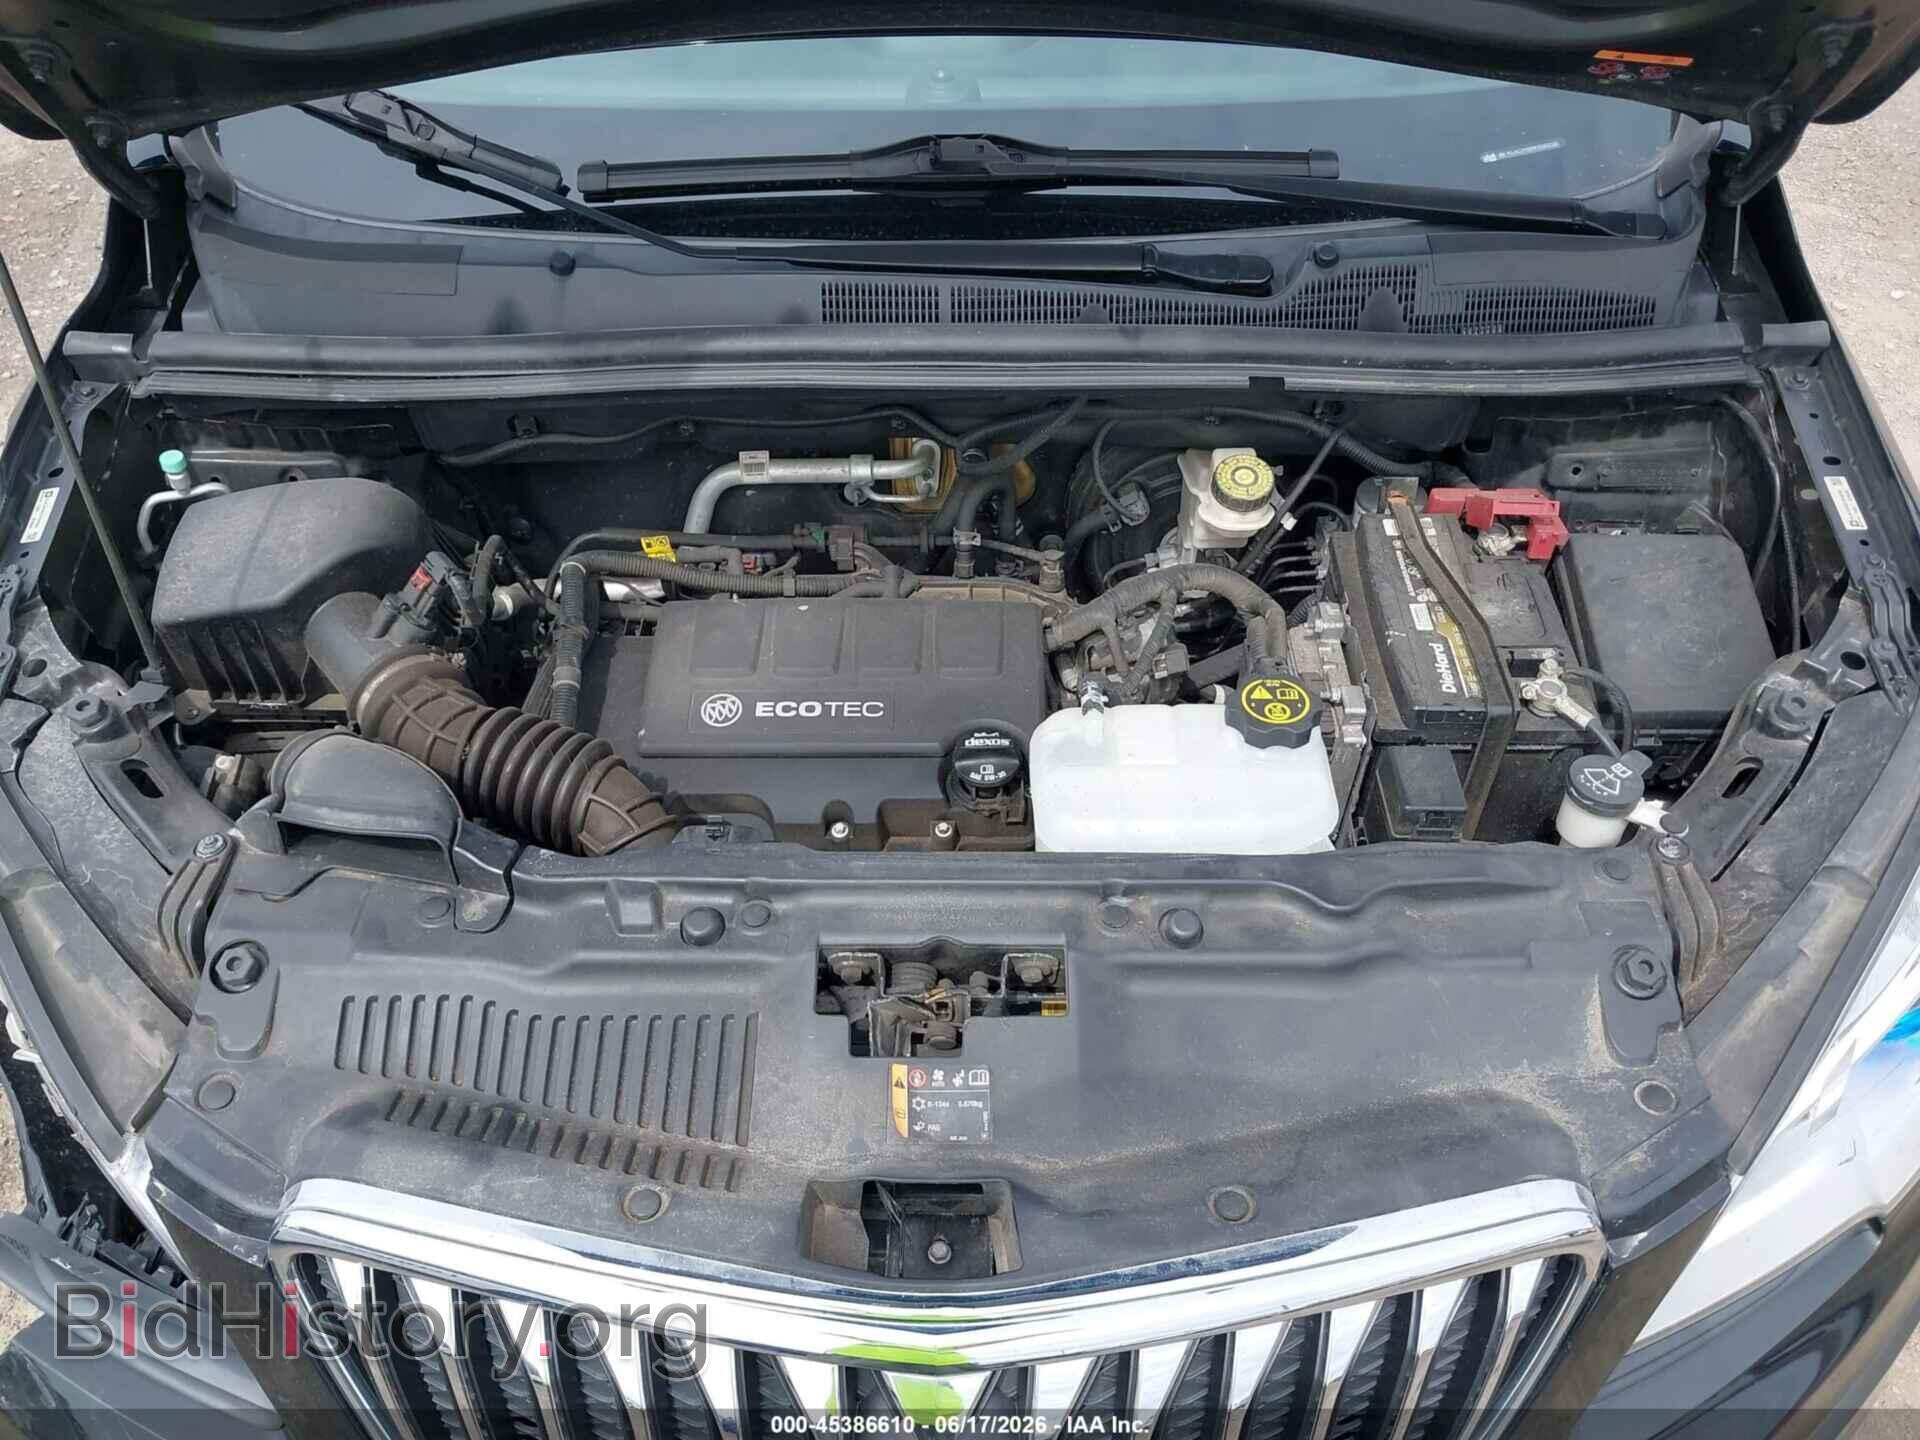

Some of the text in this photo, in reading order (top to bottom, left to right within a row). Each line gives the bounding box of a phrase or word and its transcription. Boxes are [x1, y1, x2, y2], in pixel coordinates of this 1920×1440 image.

[1428, 642, 1457, 693] DieHard
[755, 701, 884, 717] ECOTEC
[965, 737, 1011, 747] dexos
